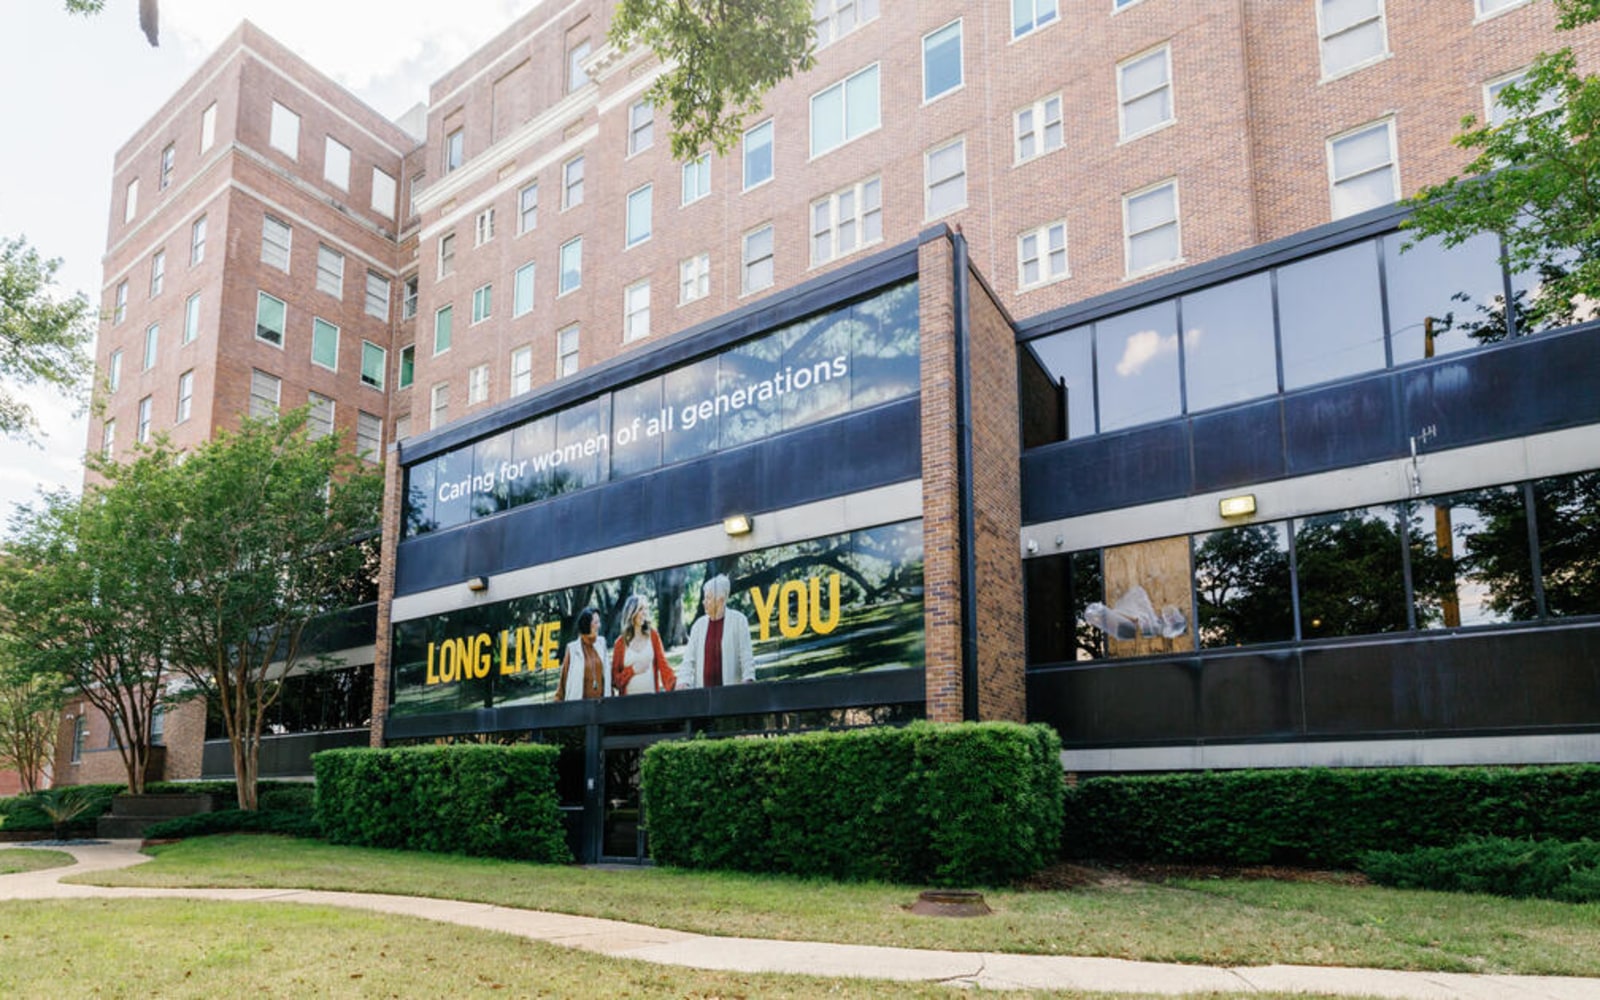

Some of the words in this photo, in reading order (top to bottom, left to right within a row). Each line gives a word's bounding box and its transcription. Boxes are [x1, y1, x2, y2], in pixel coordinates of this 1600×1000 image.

[438, 470, 495, 501] Caring
[500, 459, 527, 483] for
[533, 433, 608, 473] women
[616, 419, 640, 446] of
[646, 409, 673, 439] all
[681, 354, 848, 430] generations
[425, 632, 491, 685] LONG
[499, 621, 561, 675] LIVE
[750, 573, 841, 641] YOU
